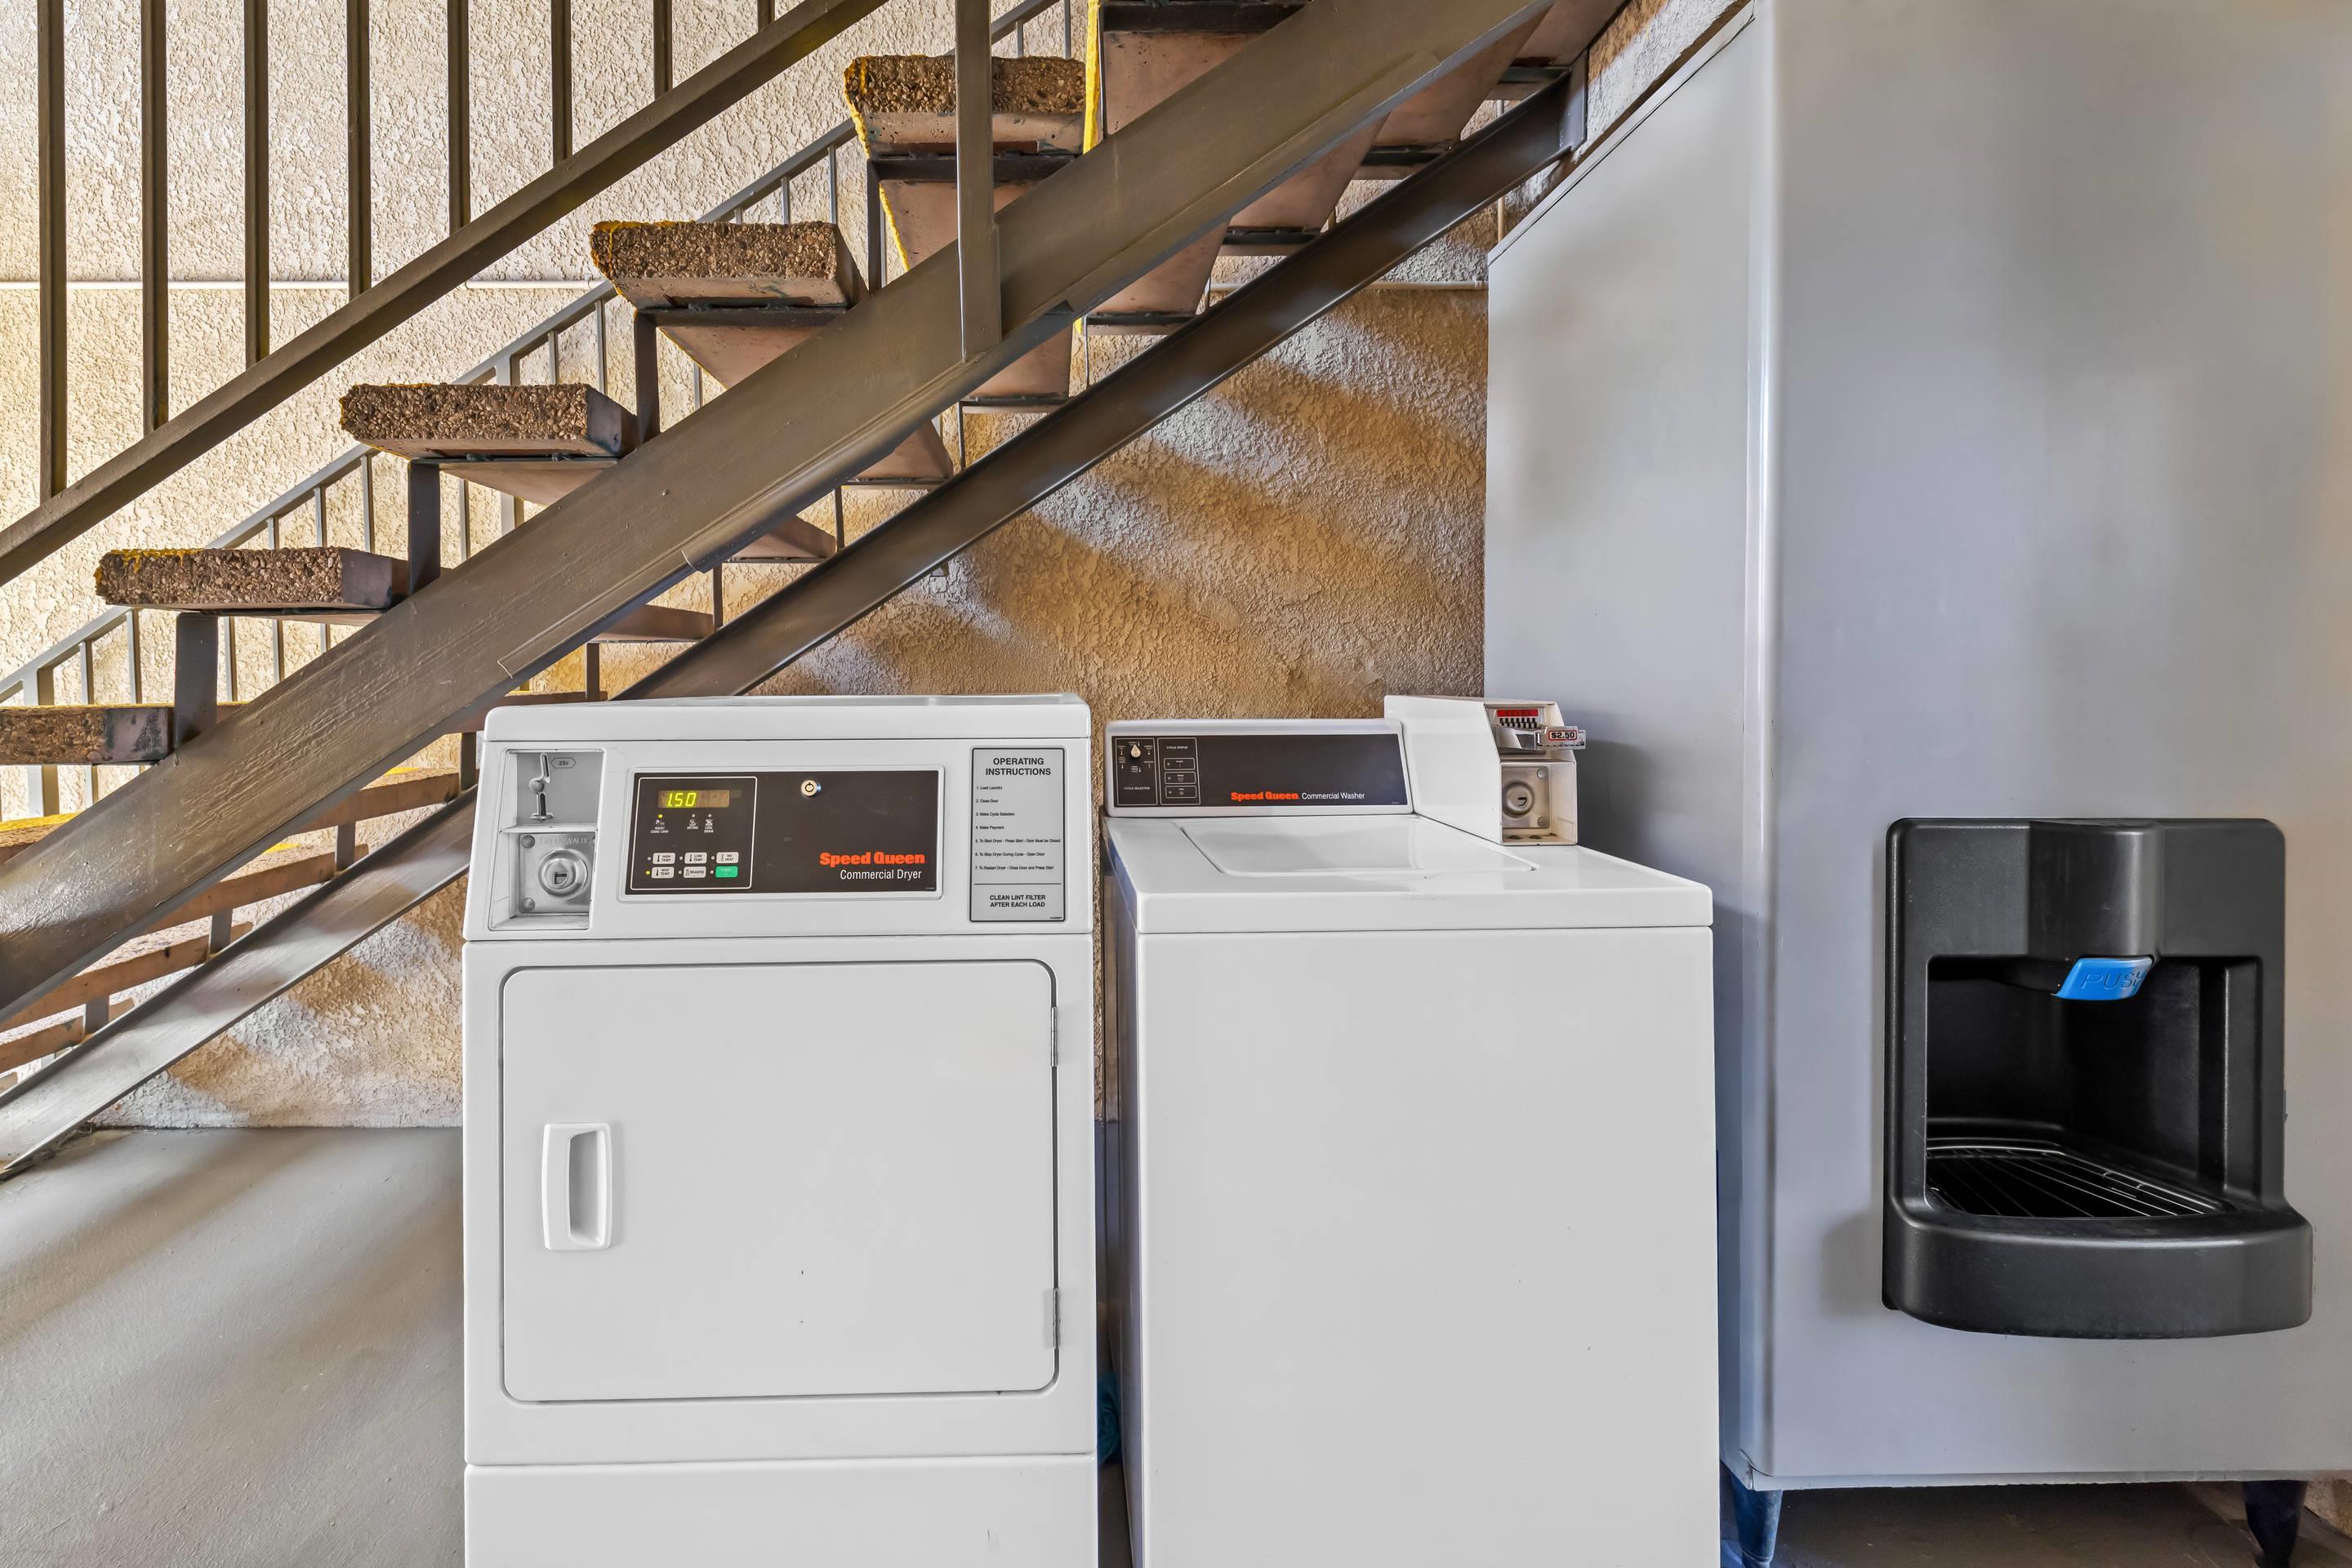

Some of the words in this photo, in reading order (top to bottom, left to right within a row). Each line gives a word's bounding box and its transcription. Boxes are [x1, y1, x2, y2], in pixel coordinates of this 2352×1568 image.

[667, 793, 697, 806] 1.50
[1231, 791, 1264, 802] Speed
[1265, 791, 1299, 800] Queen
[820, 852, 871, 867] Speed
[874, 852, 925, 864] Queen
[840, 869, 894, 880] Commercial
[897, 869, 922, 880] Dryer
[2081, 971, 2145, 990] PUSH
